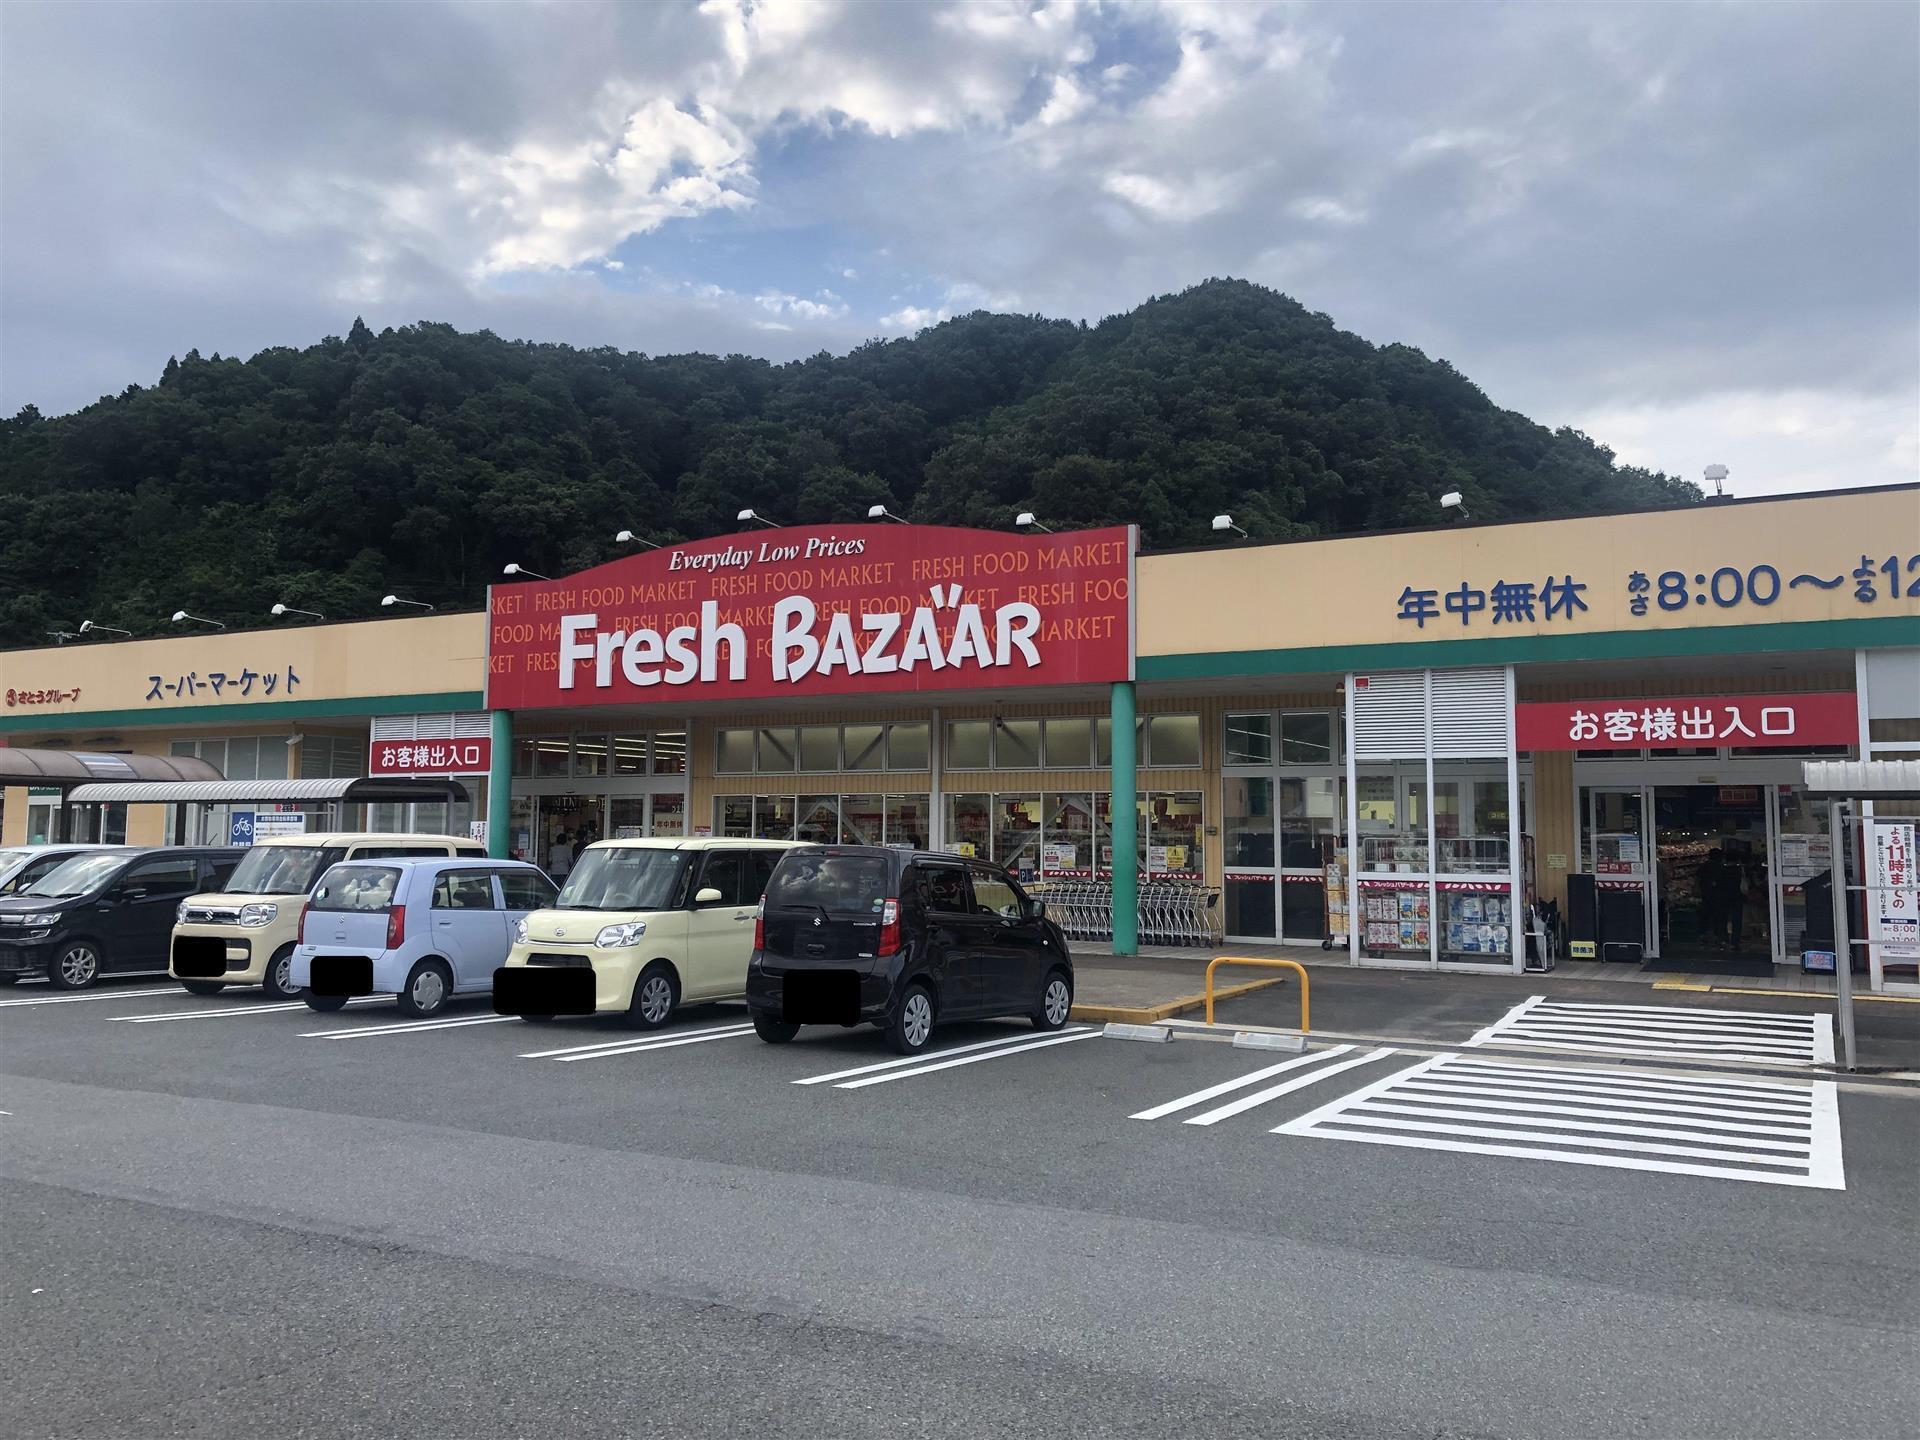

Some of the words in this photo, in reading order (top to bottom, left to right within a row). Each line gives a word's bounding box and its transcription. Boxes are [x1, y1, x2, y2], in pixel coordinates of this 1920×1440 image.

[668, 545, 753, 573] Everyday
[757, 542, 799, 564] Low
[803, 535, 865, 559] Prices
[912, 555, 964, 581] FRESH
[973, 551, 1029, 576] FOOD
[1037, 541, 1125, 570] MARKET
[711, 574, 757, 597] FRESH
[765, 570, 813, 593] FOOD
[820, 562, 895, 588] MARKET
[1018, 582, 1075, 606] FRESH
[535, 590, 576, 612] FRESH
[582, 587, 625, 608] FOOD
[631, 580, 696, 604] MARKET
[814, 600, 851, 622] RESH
[860, 595, 911, 618] FOOD
[1396, 575, 1589, 628] 年中無休
[665, 612, 699, 632] FOO
[717, 605, 775, 627] MARKE
[494, 624, 534, 645] FOOD
[558, 600, 747, 689] Fresh
[527, 652, 560, 672] FRES
[18, 688, 81, 704] さとうグループ
[145, 665, 301, 700] スーパーマーケット
[1569, 706, 1796, 742] お客様出入口
[381, 745, 480, 768] お客様出入口
[1893, 924, 1916, 933] 8:00
